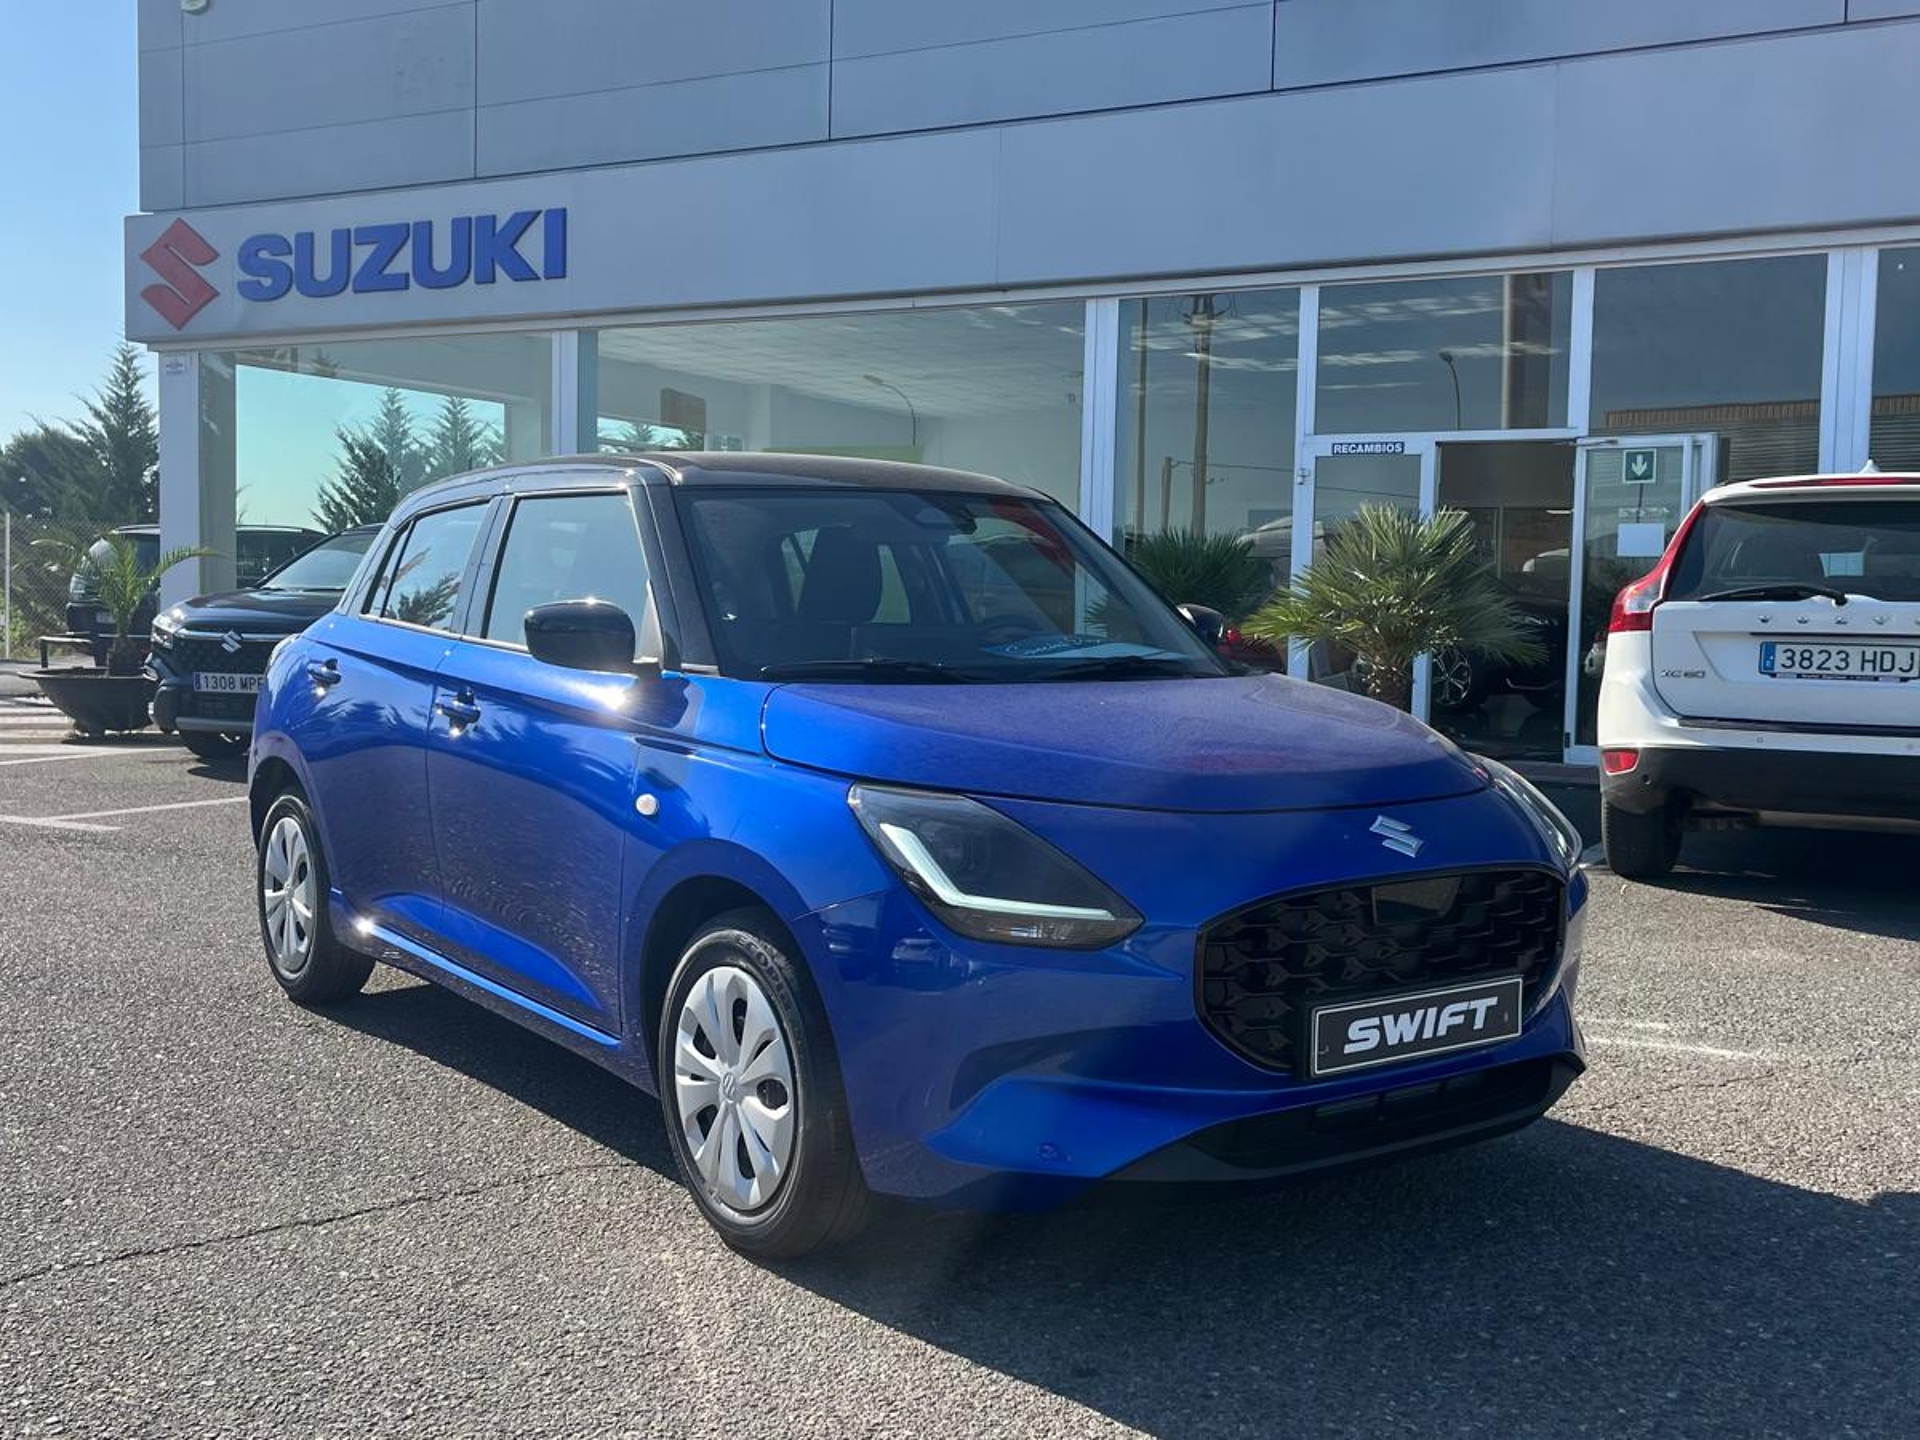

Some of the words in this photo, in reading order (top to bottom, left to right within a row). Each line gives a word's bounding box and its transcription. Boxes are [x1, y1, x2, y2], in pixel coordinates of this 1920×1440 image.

[237, 208, 567, 302] SUZUKI
[1333, 442, 1402, 454] RECAMBIOS
[1780, 648, 1850, 671] 3823
[1860, 650, 1915, 673] HDJ
[204, 675, 236, 690] 1308
[1343, 996, 1499, 1054] SWIFT
